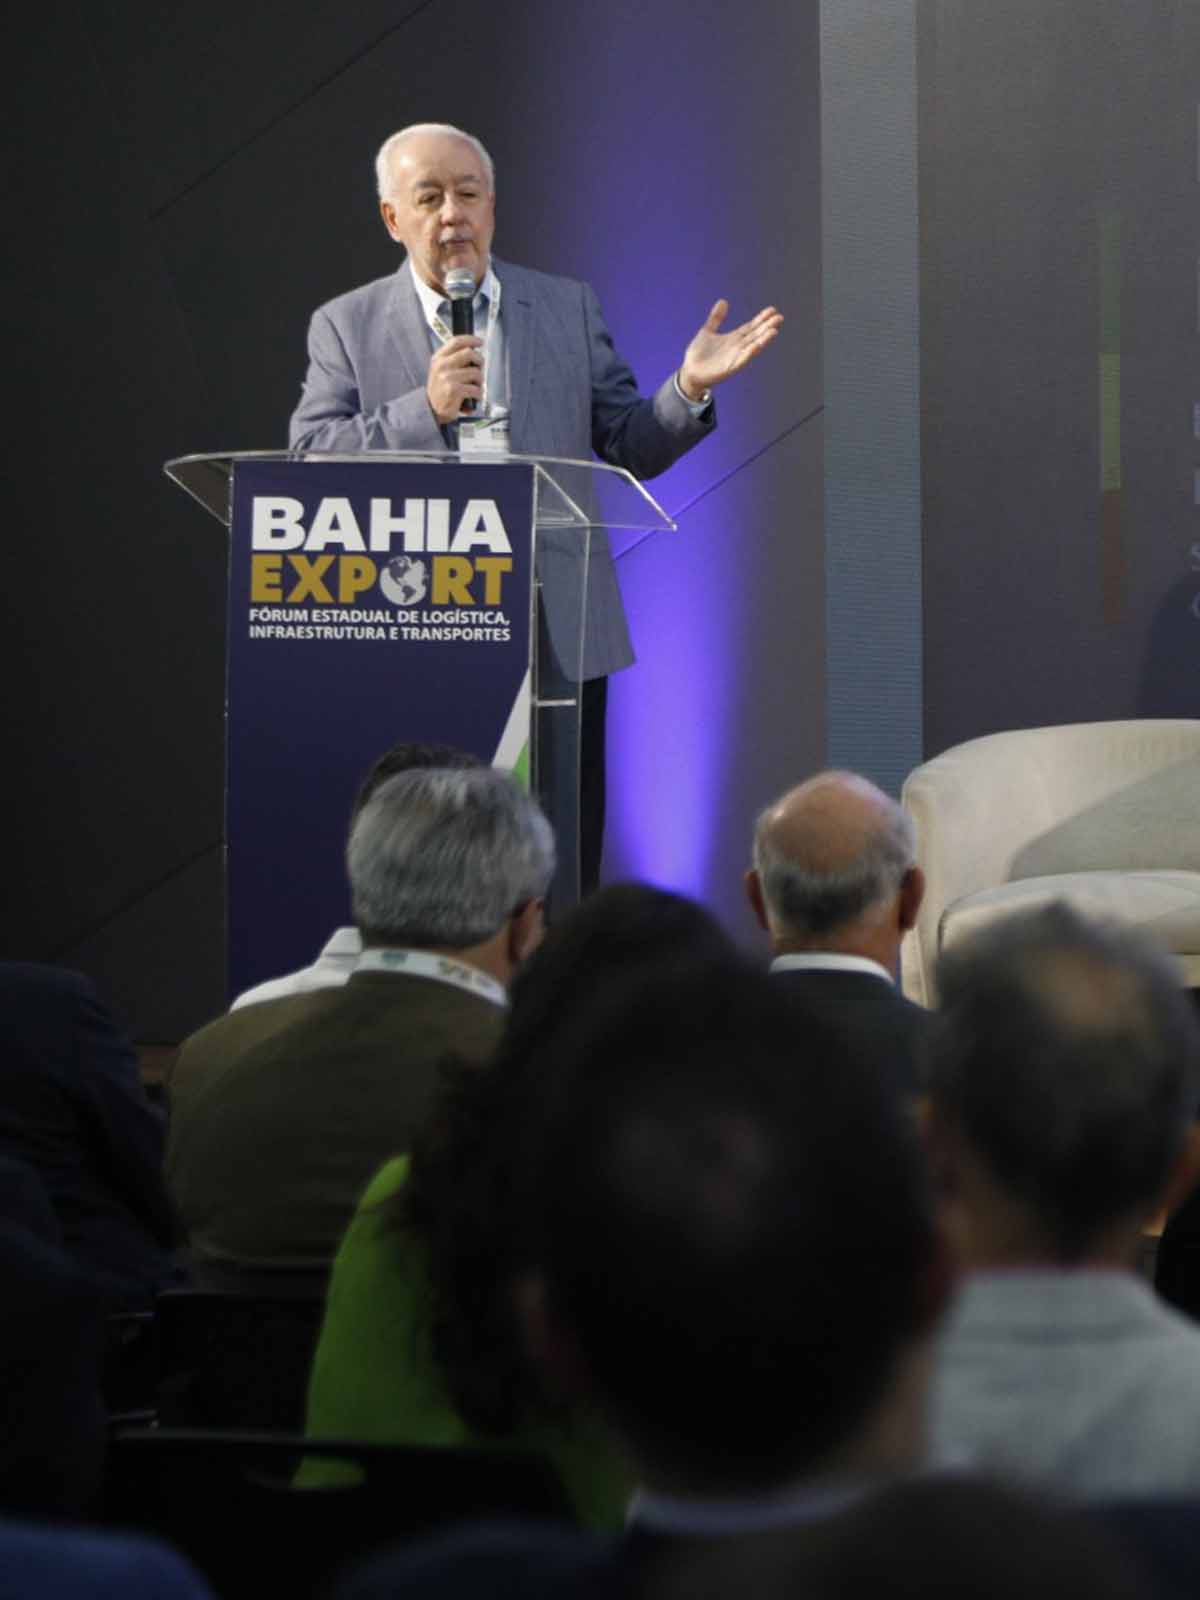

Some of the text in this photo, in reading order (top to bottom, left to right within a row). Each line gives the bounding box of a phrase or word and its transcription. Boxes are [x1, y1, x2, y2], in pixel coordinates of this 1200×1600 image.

[252, 496, 512, 553] BAHIA
[249, 606, 511, 626] FÓRUM ESTADUAL DE LOGÍSTICA,
[249, 625, 511, 642] INFRAESTRUTURA E TRANSPORTES
